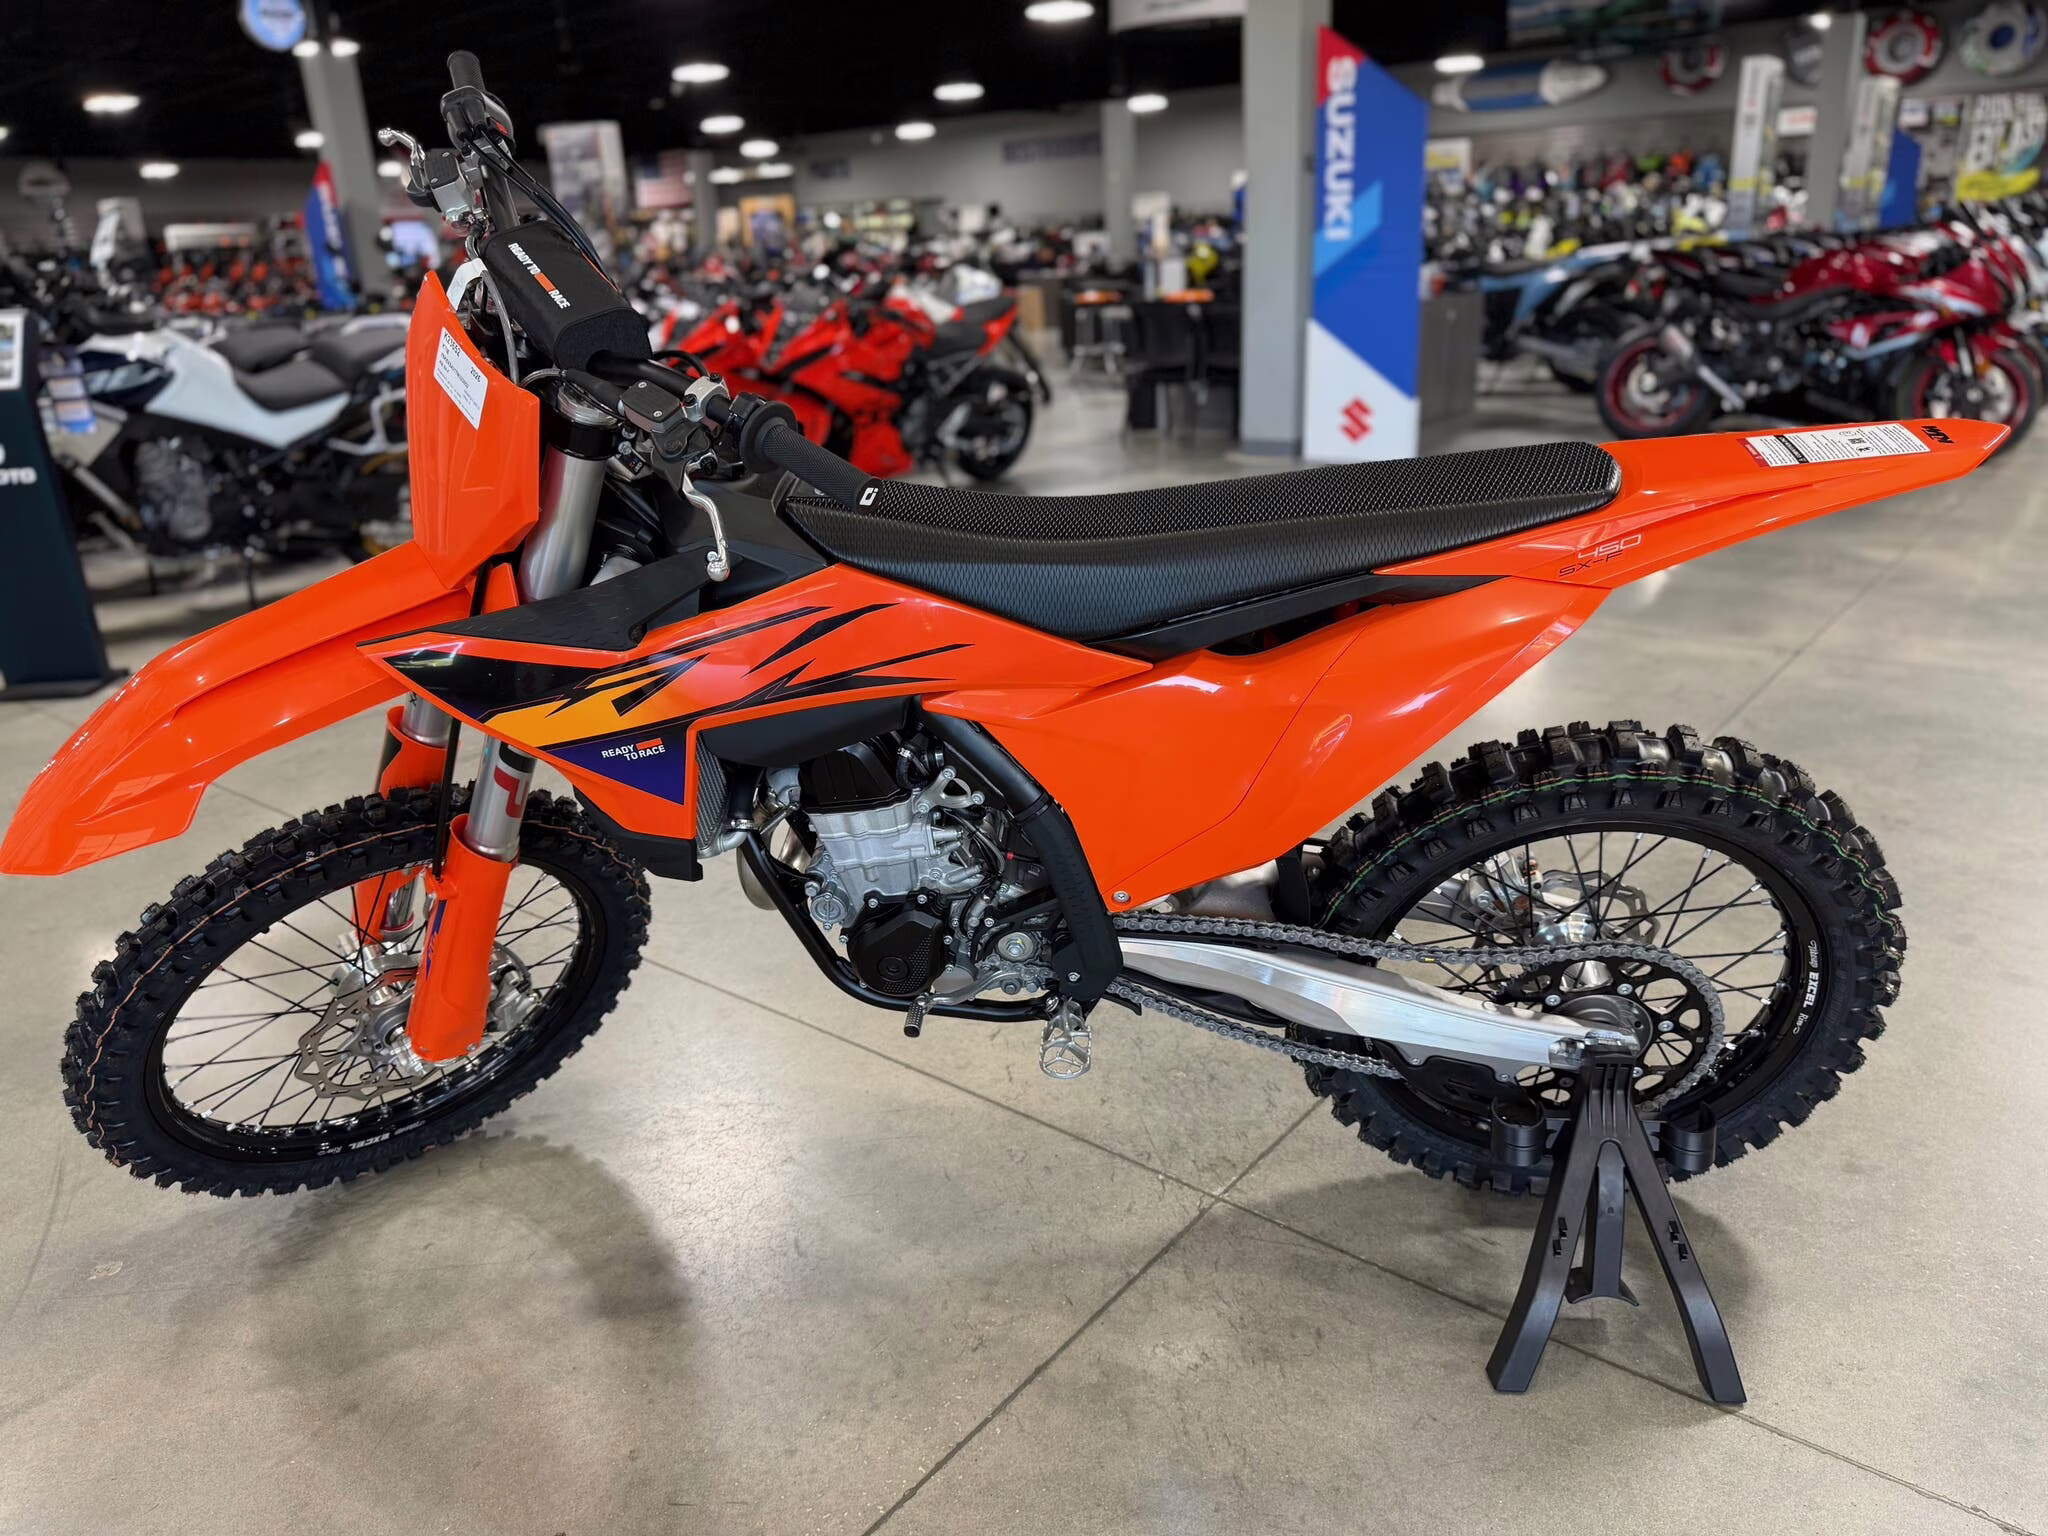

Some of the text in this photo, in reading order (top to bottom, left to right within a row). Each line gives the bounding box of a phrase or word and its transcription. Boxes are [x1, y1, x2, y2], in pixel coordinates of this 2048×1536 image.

[1324, 55, 1357, 242] SUZUKI
[508, 242, 541, 275] READY TO
[548, 289, 571, 309] RACE
[1578, 533, 1642, 559] 450
[1558, 550, 1623, 577] SX-F
[601, 744, 634, 758] READY
[624, 745, 666, 761] TO RACE
[1803, 971, 1819, 1008] EXCEL
